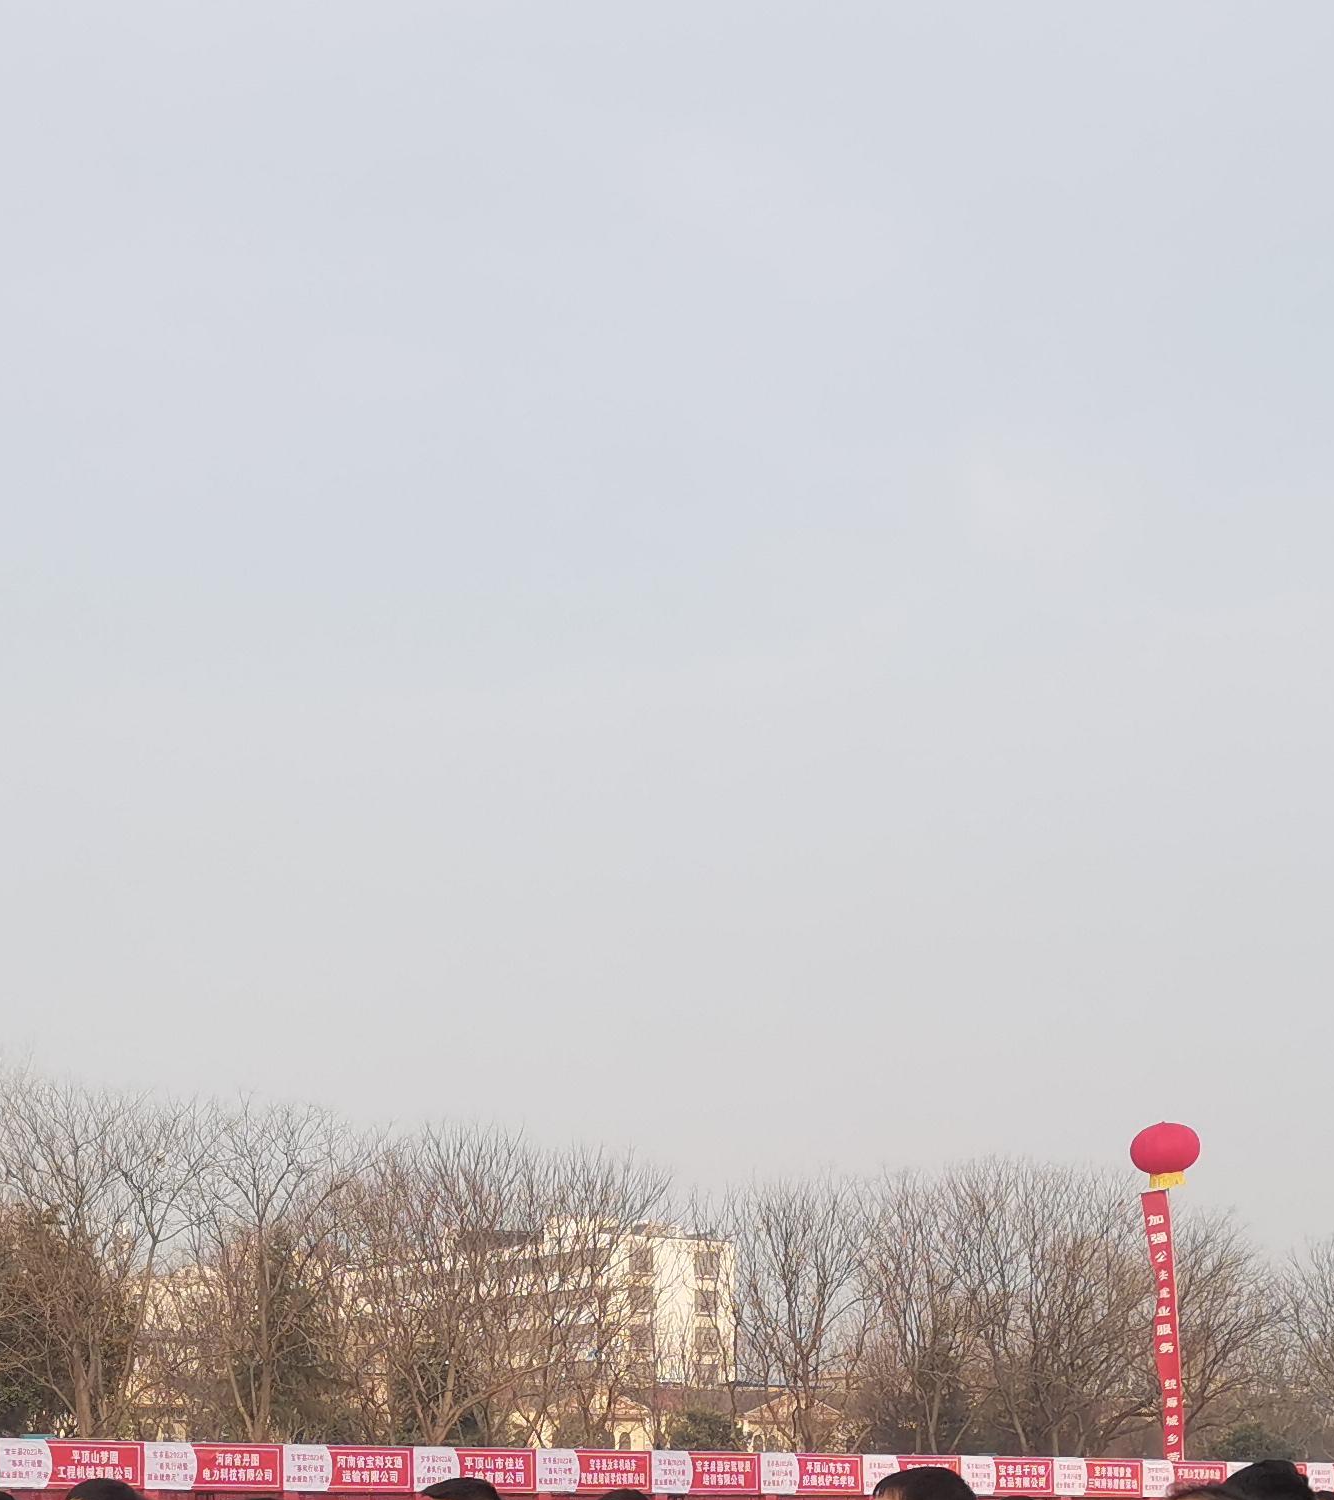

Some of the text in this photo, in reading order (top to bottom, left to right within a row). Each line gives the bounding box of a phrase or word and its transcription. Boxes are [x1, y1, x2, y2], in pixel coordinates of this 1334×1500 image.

[57, 1466, 133, 1480] 工程机械有限公司
[202, 1468, 273, 1482] 电力科技有限公司
[342, 1470, 398, 1483] 运输有限公司
